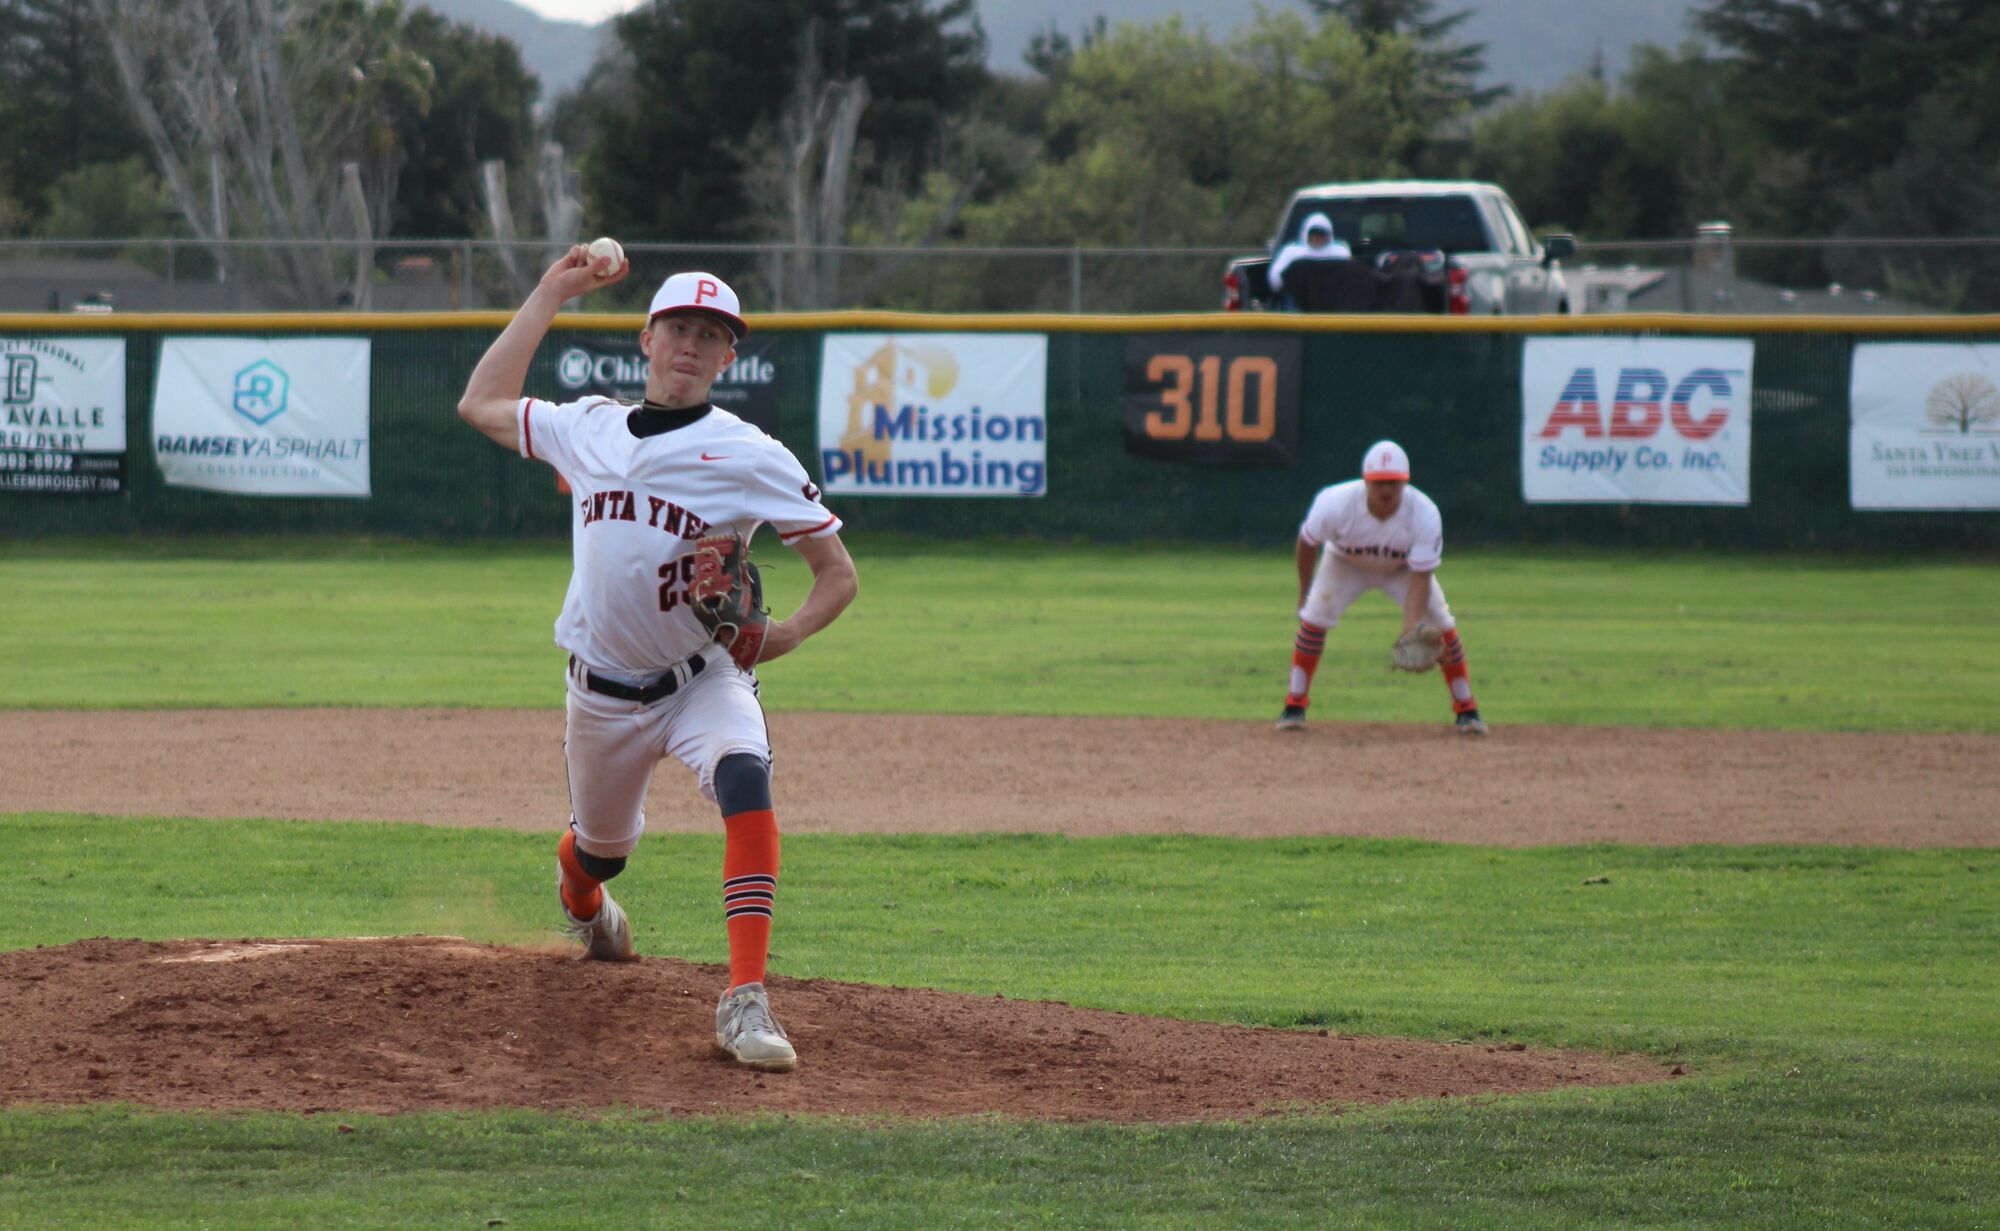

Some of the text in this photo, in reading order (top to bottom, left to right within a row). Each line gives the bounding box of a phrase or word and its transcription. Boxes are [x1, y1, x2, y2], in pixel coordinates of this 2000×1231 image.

[695, 279, 718, 304] P
[1145, 354, 1277, 442] 310
[1539, 367, 1735, 442] ABC
[7, 406, 104, 428] AVALLE
[874, 404, 1045, 441] Mission
[822, 449, 1045, 493] Plumbing
[1539, 446, 1628, 472] Supply
[1634, 448, 1672, 469] Co.
